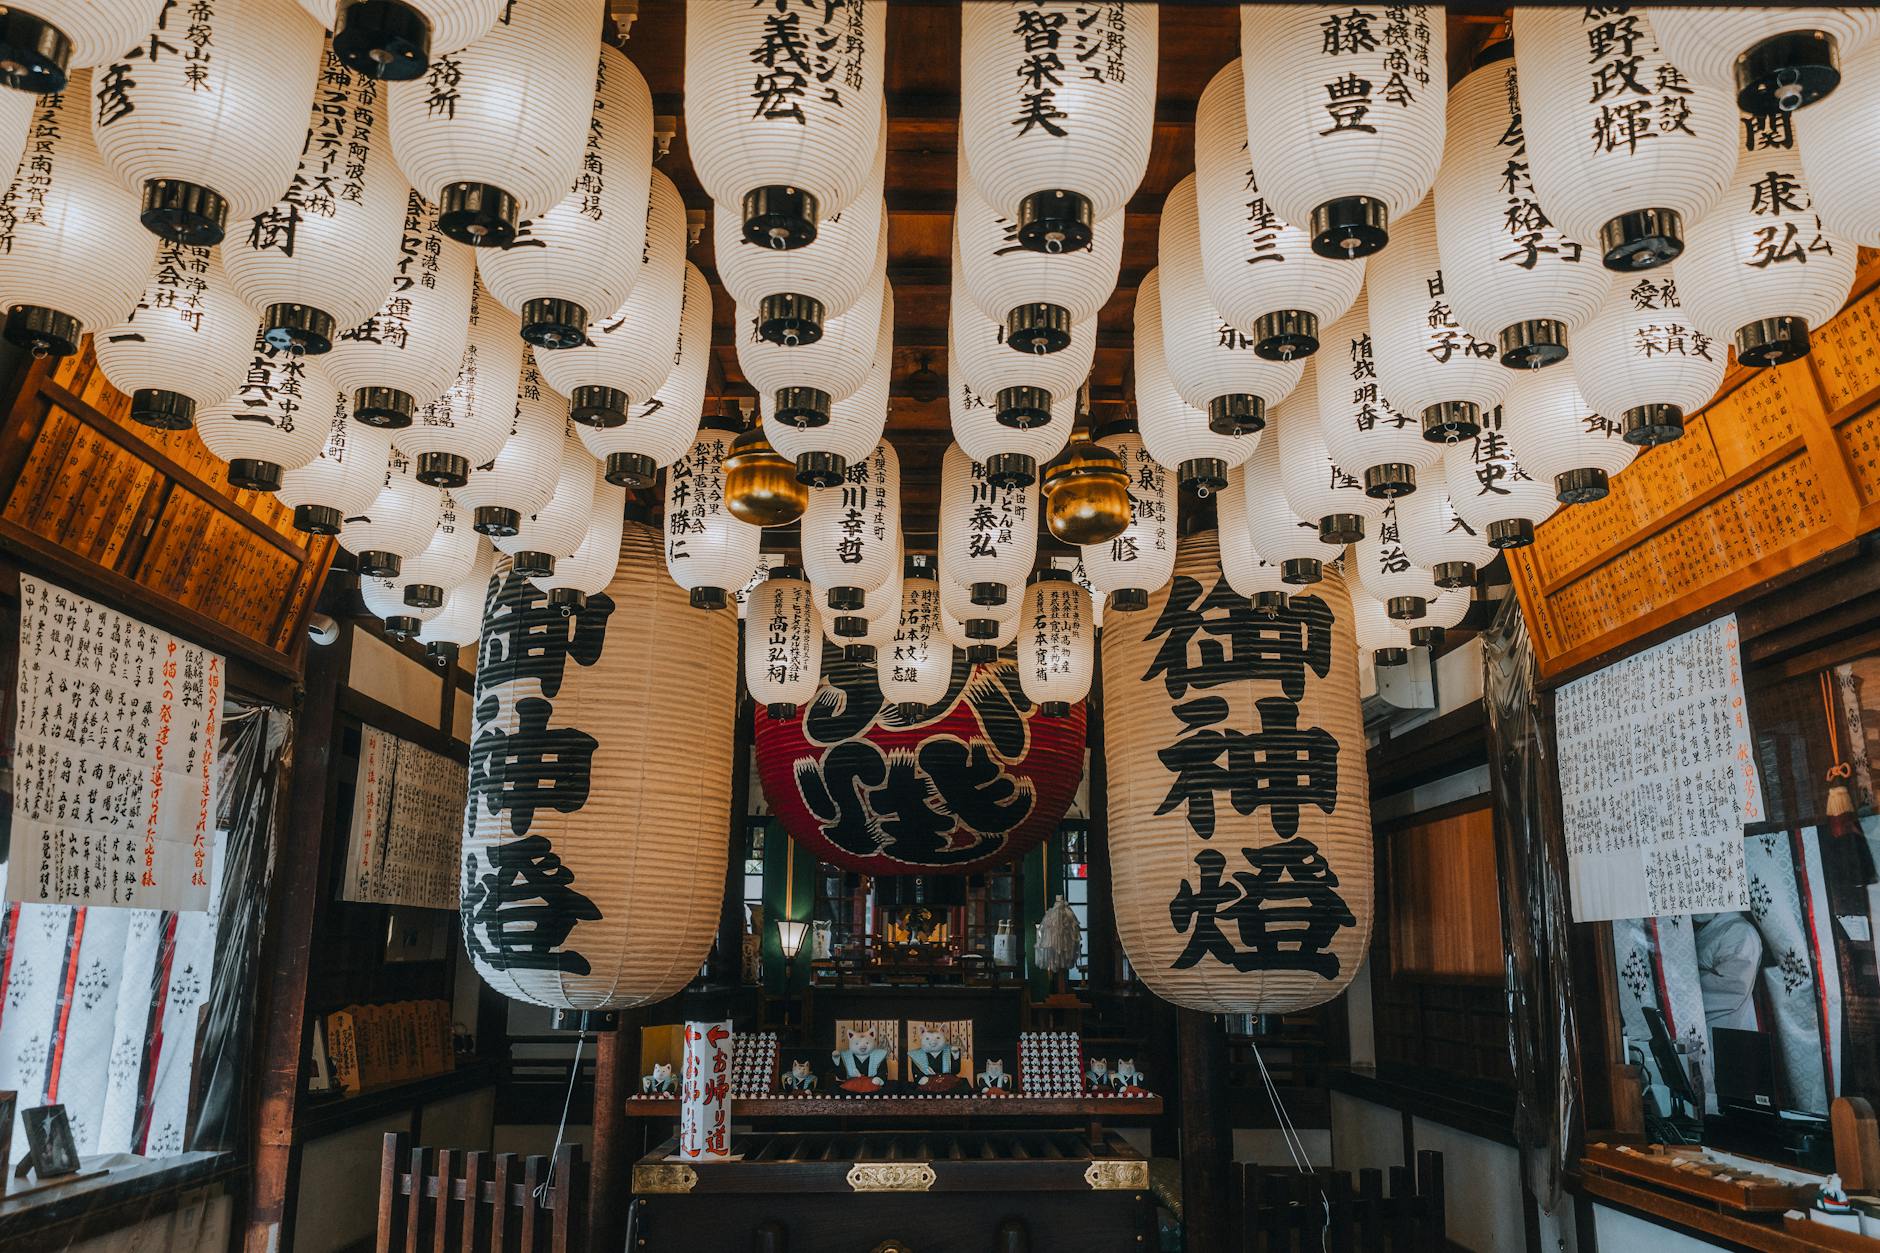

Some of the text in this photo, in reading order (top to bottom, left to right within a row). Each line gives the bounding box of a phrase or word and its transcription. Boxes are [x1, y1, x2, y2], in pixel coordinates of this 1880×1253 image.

[425, 46, 464, 120] 務所
[749, 0, 818, 125] 義宏
[1011, 10, 1069, 140] 智栄美
[1377, 5, 1416, 107] 電機商会
[1656, 63, 1696, 136] 建設
[276, 350, 306, 433] 水産中島
[524, 341, 540, 401] 区波除
[691, 442, 711, 534] 松井電気商会
[874, 446, 887, 541] 天理市田井庄町
[1141, 570, 1357, 981] 御神燈
[703, 1047, 730, 1157] お帰り道
